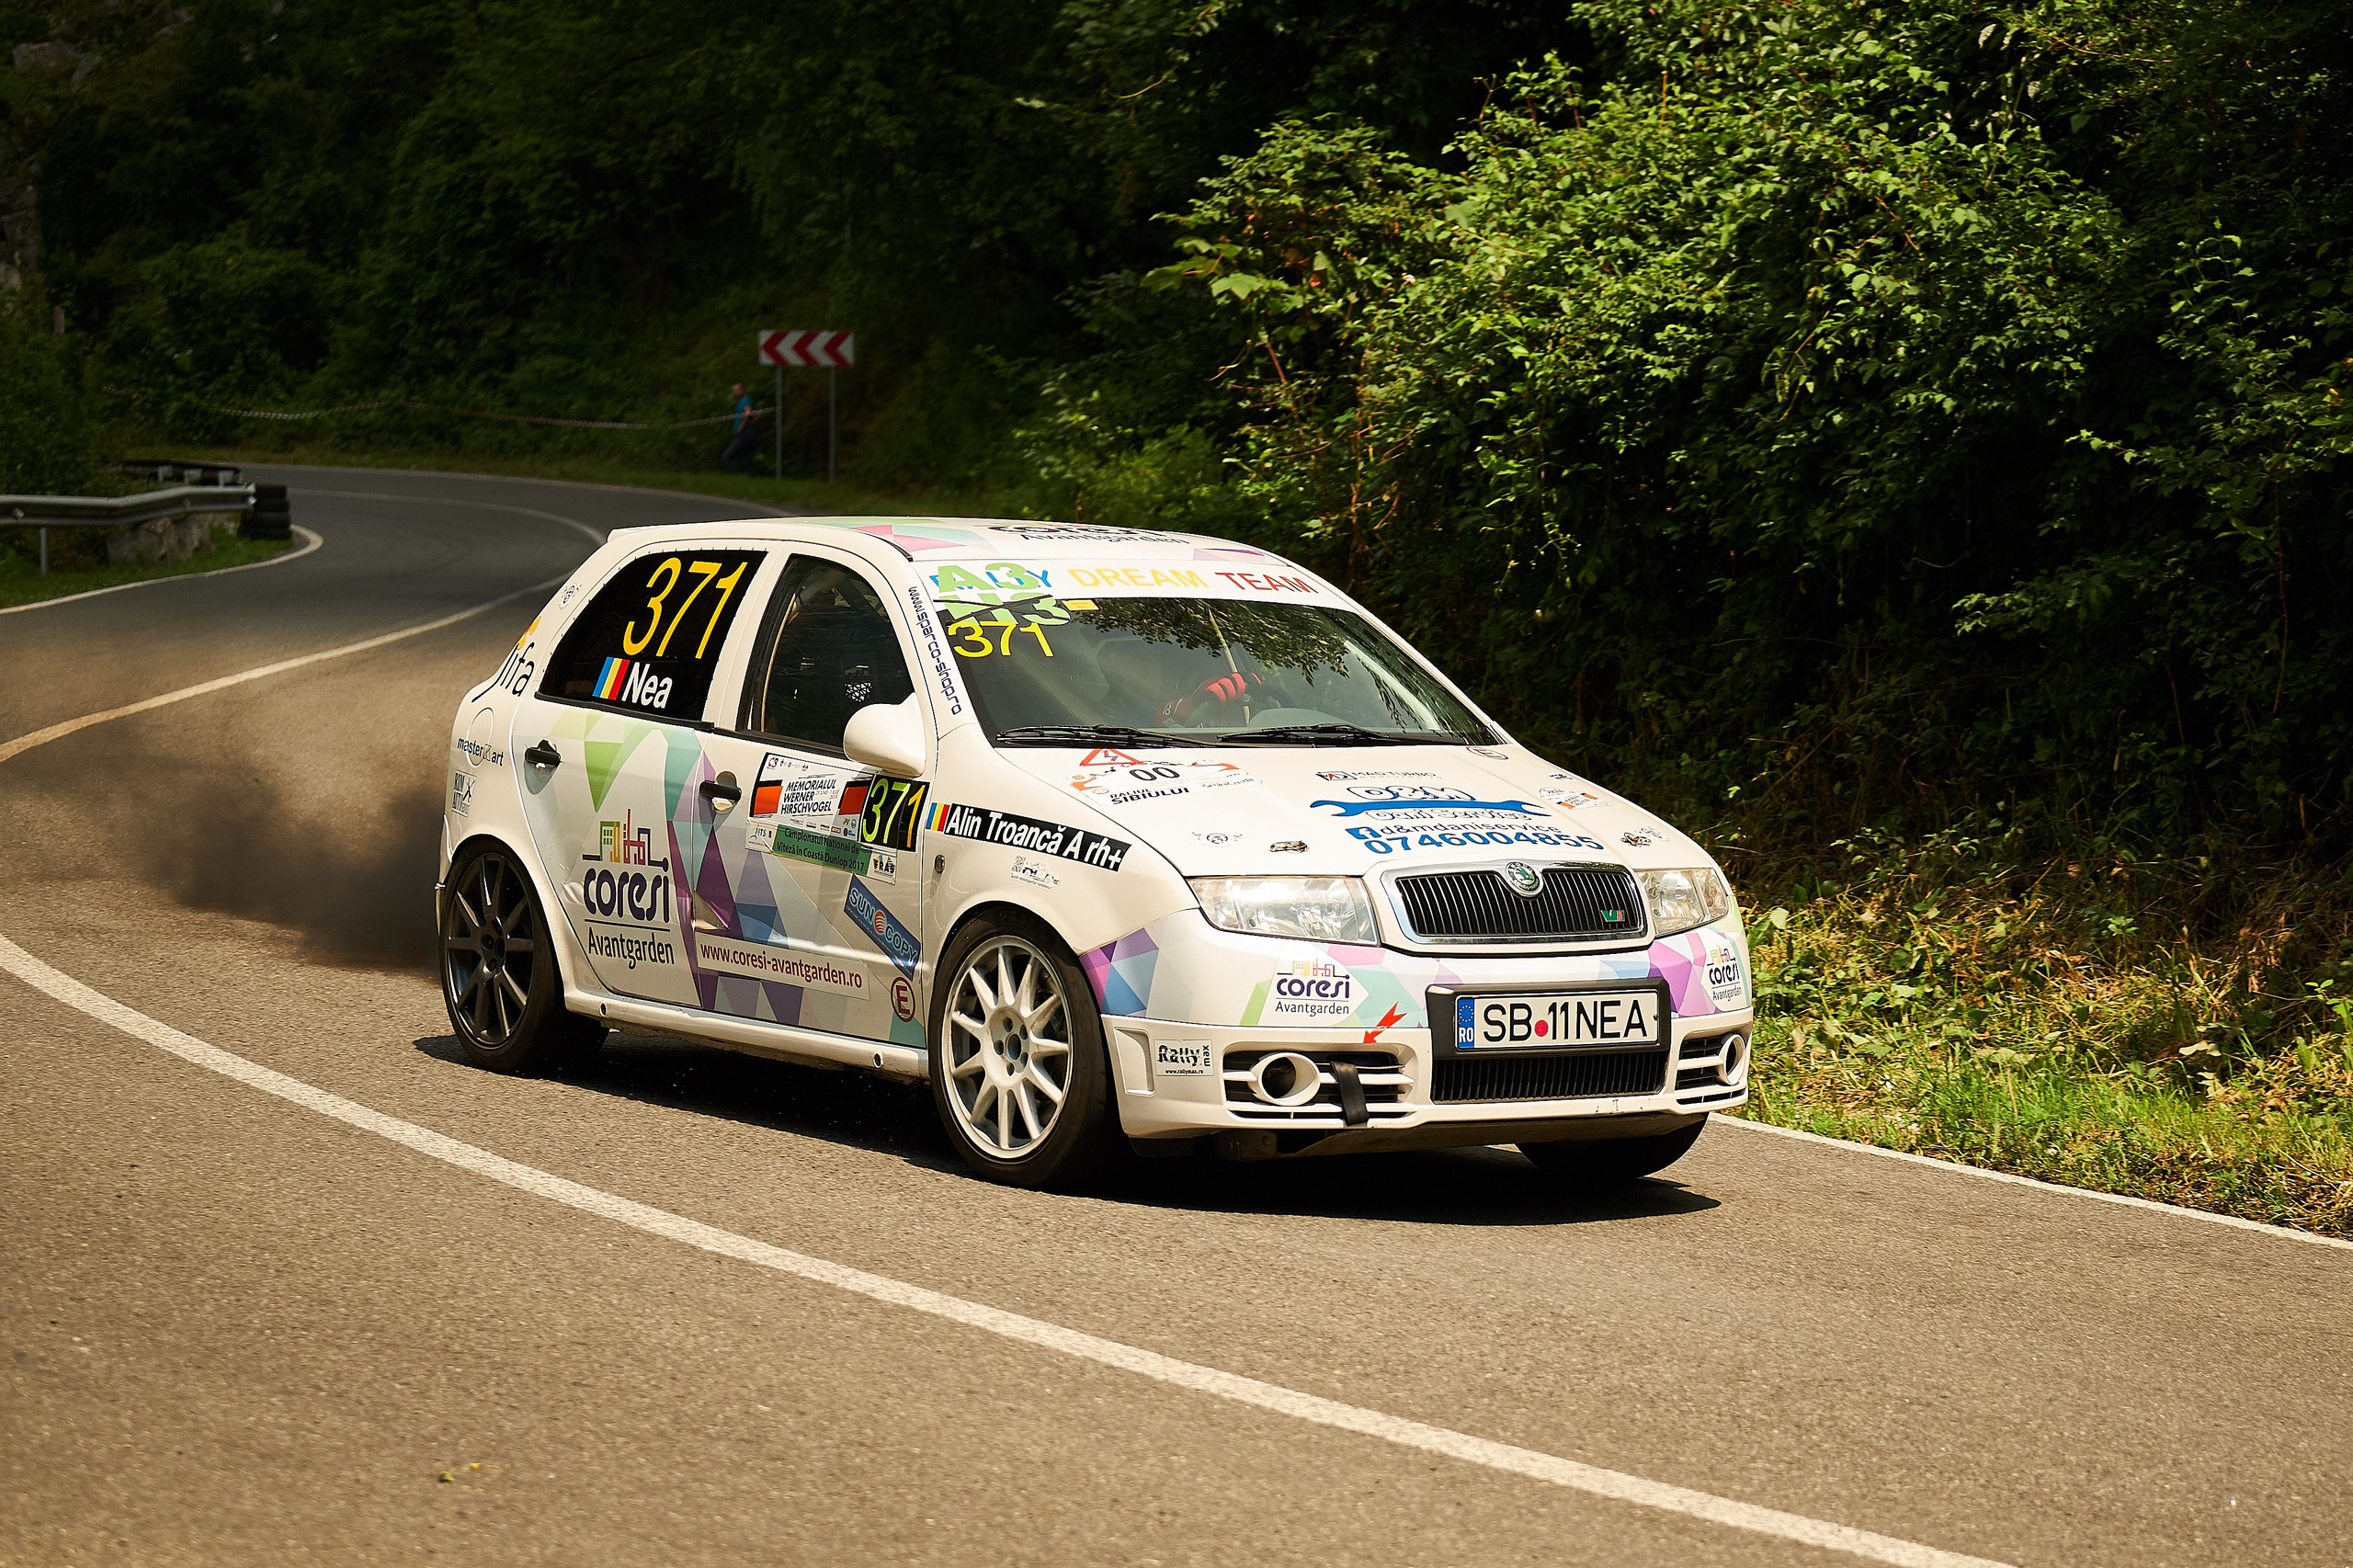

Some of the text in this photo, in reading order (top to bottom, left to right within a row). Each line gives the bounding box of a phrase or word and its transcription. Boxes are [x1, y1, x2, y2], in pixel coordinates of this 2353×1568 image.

[938, 562, 1040, 593] A3
[1067, 568, 1210, 588] DREAM
[1214, 572, 1319, 594] TEAM
[623, 557, 748, 659] 371
[908, 585, 962, 715] www.sparco-shop.ro
[948, 620, 1054, 659] 371
[621, 661, 673, 709] Nea
[786, 779, 837, 792] MEMORIALUL
[1129, 767, 1180, 781] 00
[781, 801, 833, 815] HIRSCHVOGEL
[783, 791, 815, 803] WERNER
[1111, 787, 1190, 805] SIBIULUI
[862, 778, 926, 847] 371
[785, 827, 824, 843] Campionatul
[851, 844, 859, 854] de
[946, 806, 1122, 869] Alin Troancă A rh+
[1380, 822, 1563, 835] d&mdaniservice
[777, 841, 796, 855] Viteză
[796, 846, 802, 856] în
[803, 847, 824, 861] Coastă
[824, 853, 847, 869] Dunlop
[848, 859, 864, 871] 2017
[1364, 831, 1605, 855] 0746004855
[584, 868, 669, 923] coresi
[849, 888, 874, 924] SUN
[884, 925, 917, 965] COPY
[588, 926, 675, 970] Avantgarden
[700, 943, 862, 989] www.coresi-avantgarden.ro
[1710, 962, 1740, 985] coresi
[895, 984, 911, 1016] E
[1276, 978, 1350, 999] coresi
[1712, 985, 1742, 1002] Avantgarden
[1275, 1001, 1349, 1017] Avantgarden
[1459, 1027, 1473, 1042] RO
[1483, 1003, 1532, 1042] SB
[1157, 1045, 1211, 1066] Rally max
